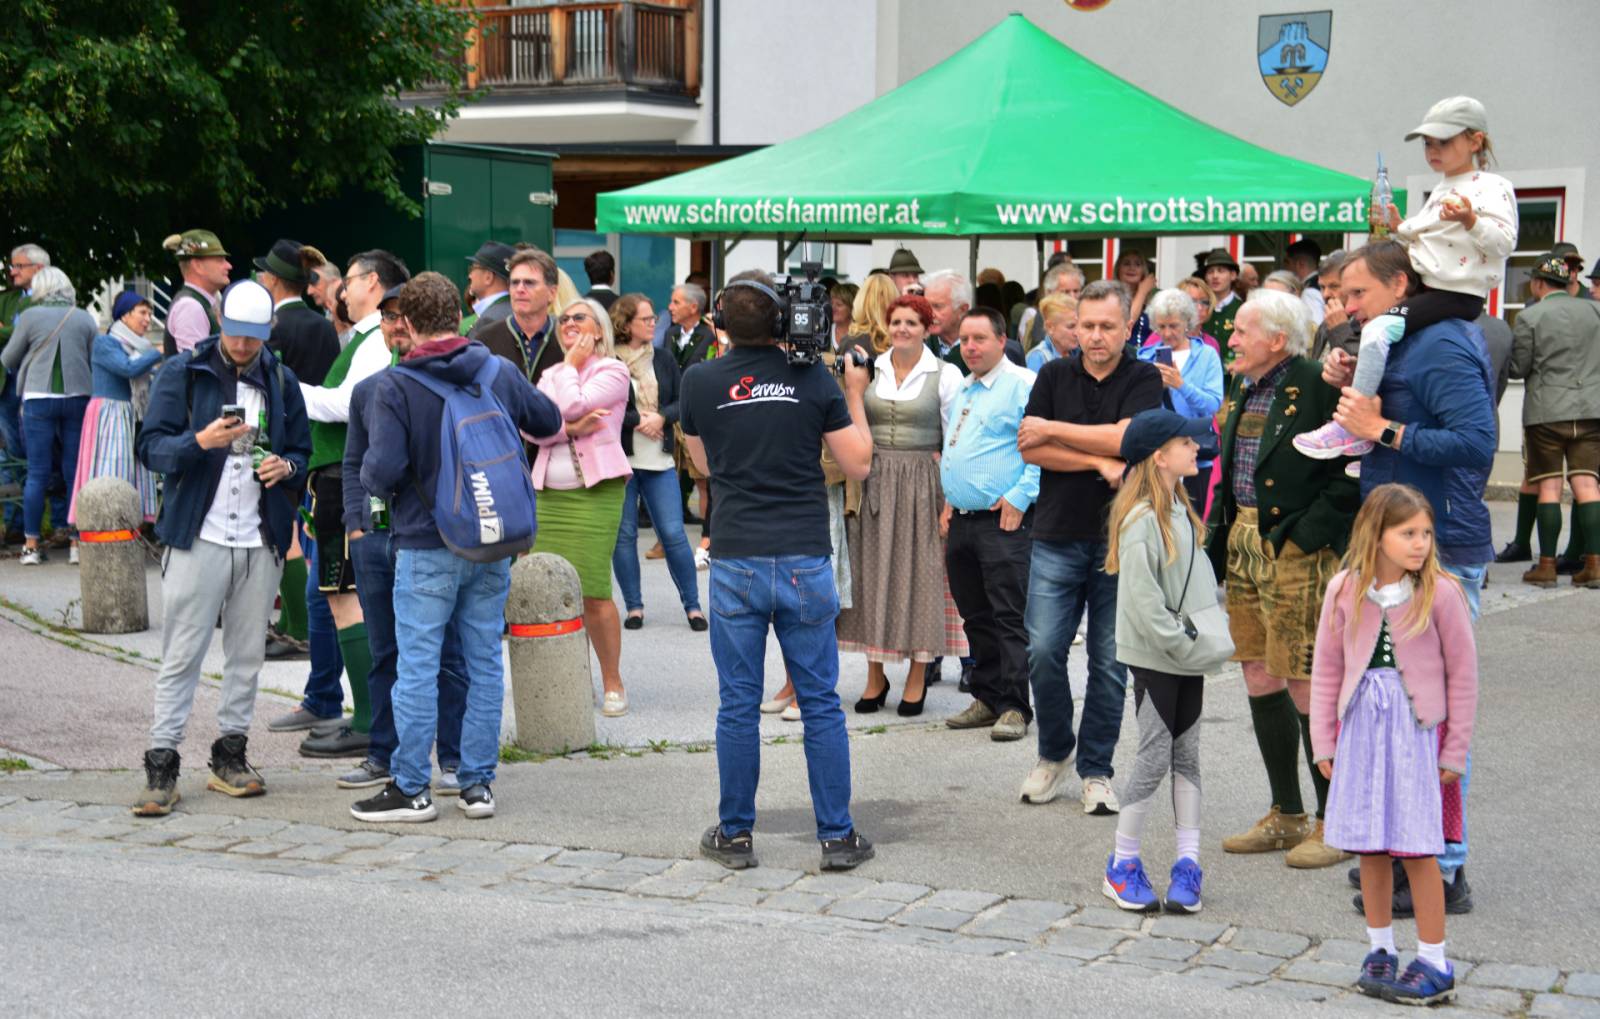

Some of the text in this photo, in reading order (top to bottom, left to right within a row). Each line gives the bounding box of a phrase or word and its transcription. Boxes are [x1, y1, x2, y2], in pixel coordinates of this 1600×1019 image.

[624, 198, 920, 226] www.schrottshammer.at
[996, 196, 1364, 225] www.schrottshammer.at
[794, 313, 809, 325] 95
[470, 471, 498, 517] PUMA
